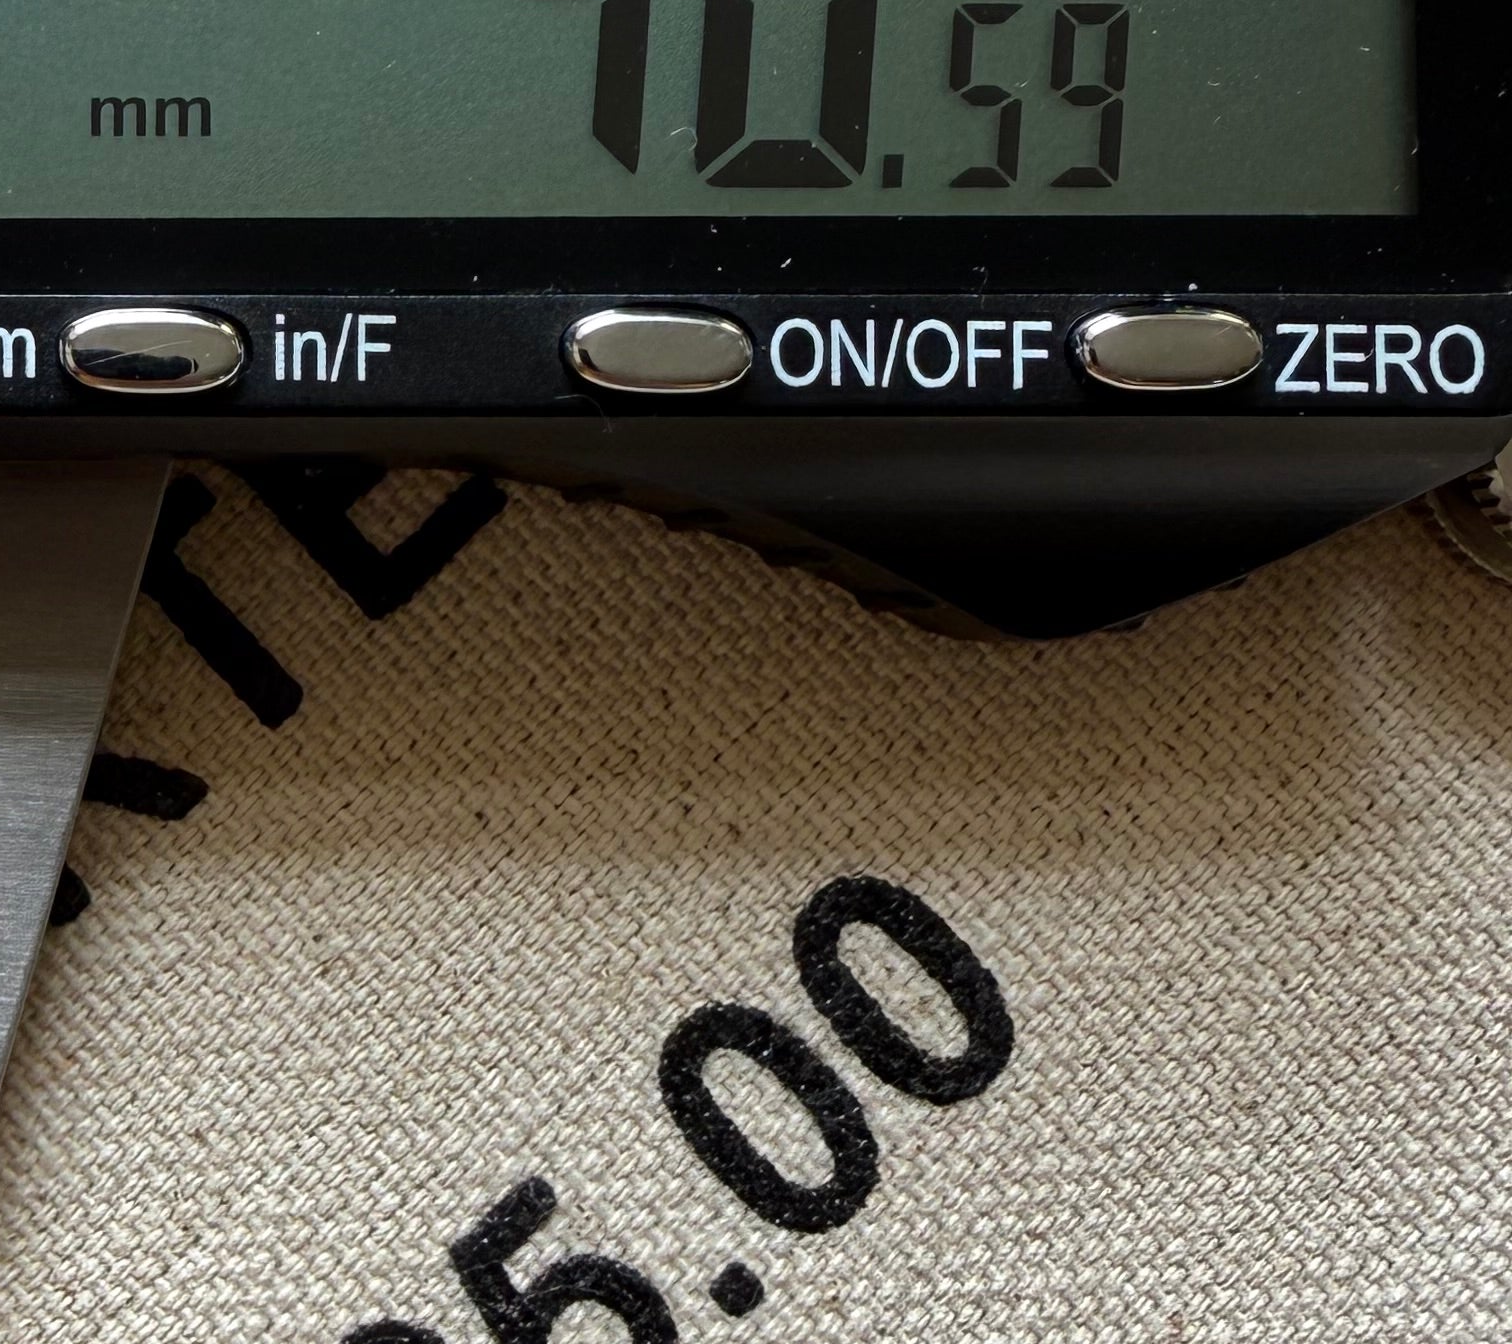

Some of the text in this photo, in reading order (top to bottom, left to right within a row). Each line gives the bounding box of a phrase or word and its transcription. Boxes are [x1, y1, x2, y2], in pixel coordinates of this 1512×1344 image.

[89, 95, 213, 138] mm
[273, 312, 398, 384] in/F
[769, 316, 1054, 391] ON/OFF
[1274, 322, 1486, 396] ZERO
